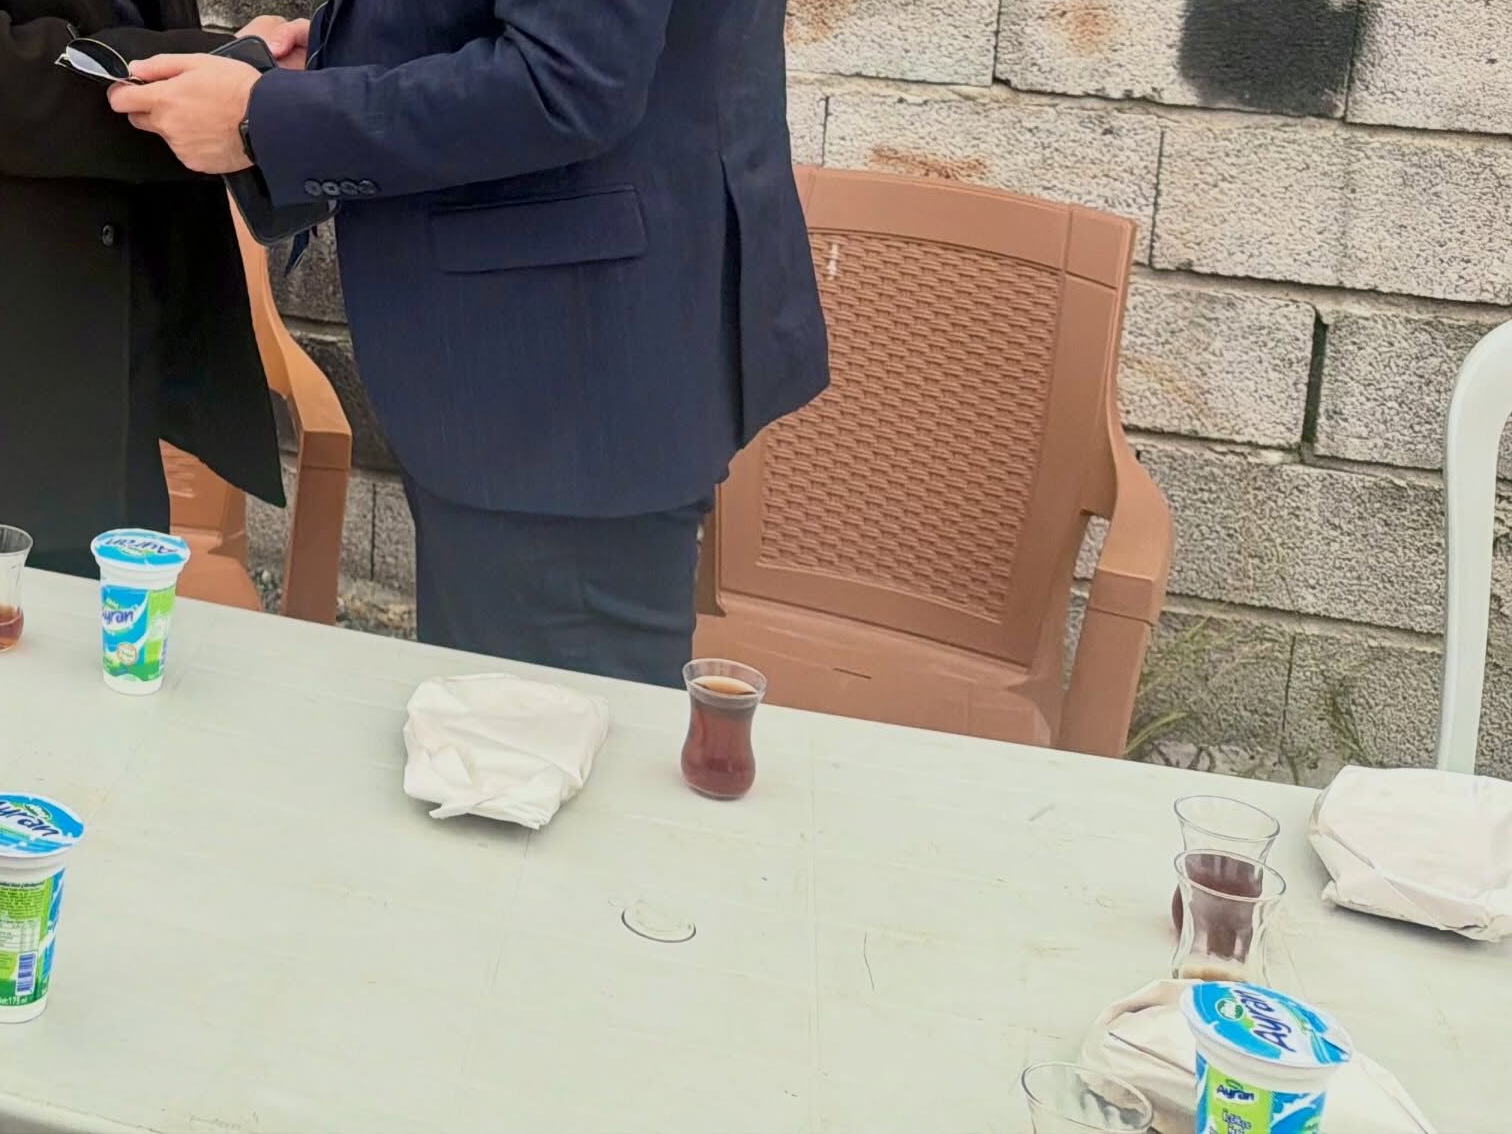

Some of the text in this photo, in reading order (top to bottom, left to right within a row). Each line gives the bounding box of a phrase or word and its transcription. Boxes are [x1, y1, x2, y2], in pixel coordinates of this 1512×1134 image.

[102, 610, 134, 625] yran
[1233, 989, 1297, 1053] Ayran
[1216, 1084, 1255, 1101] Ayran
